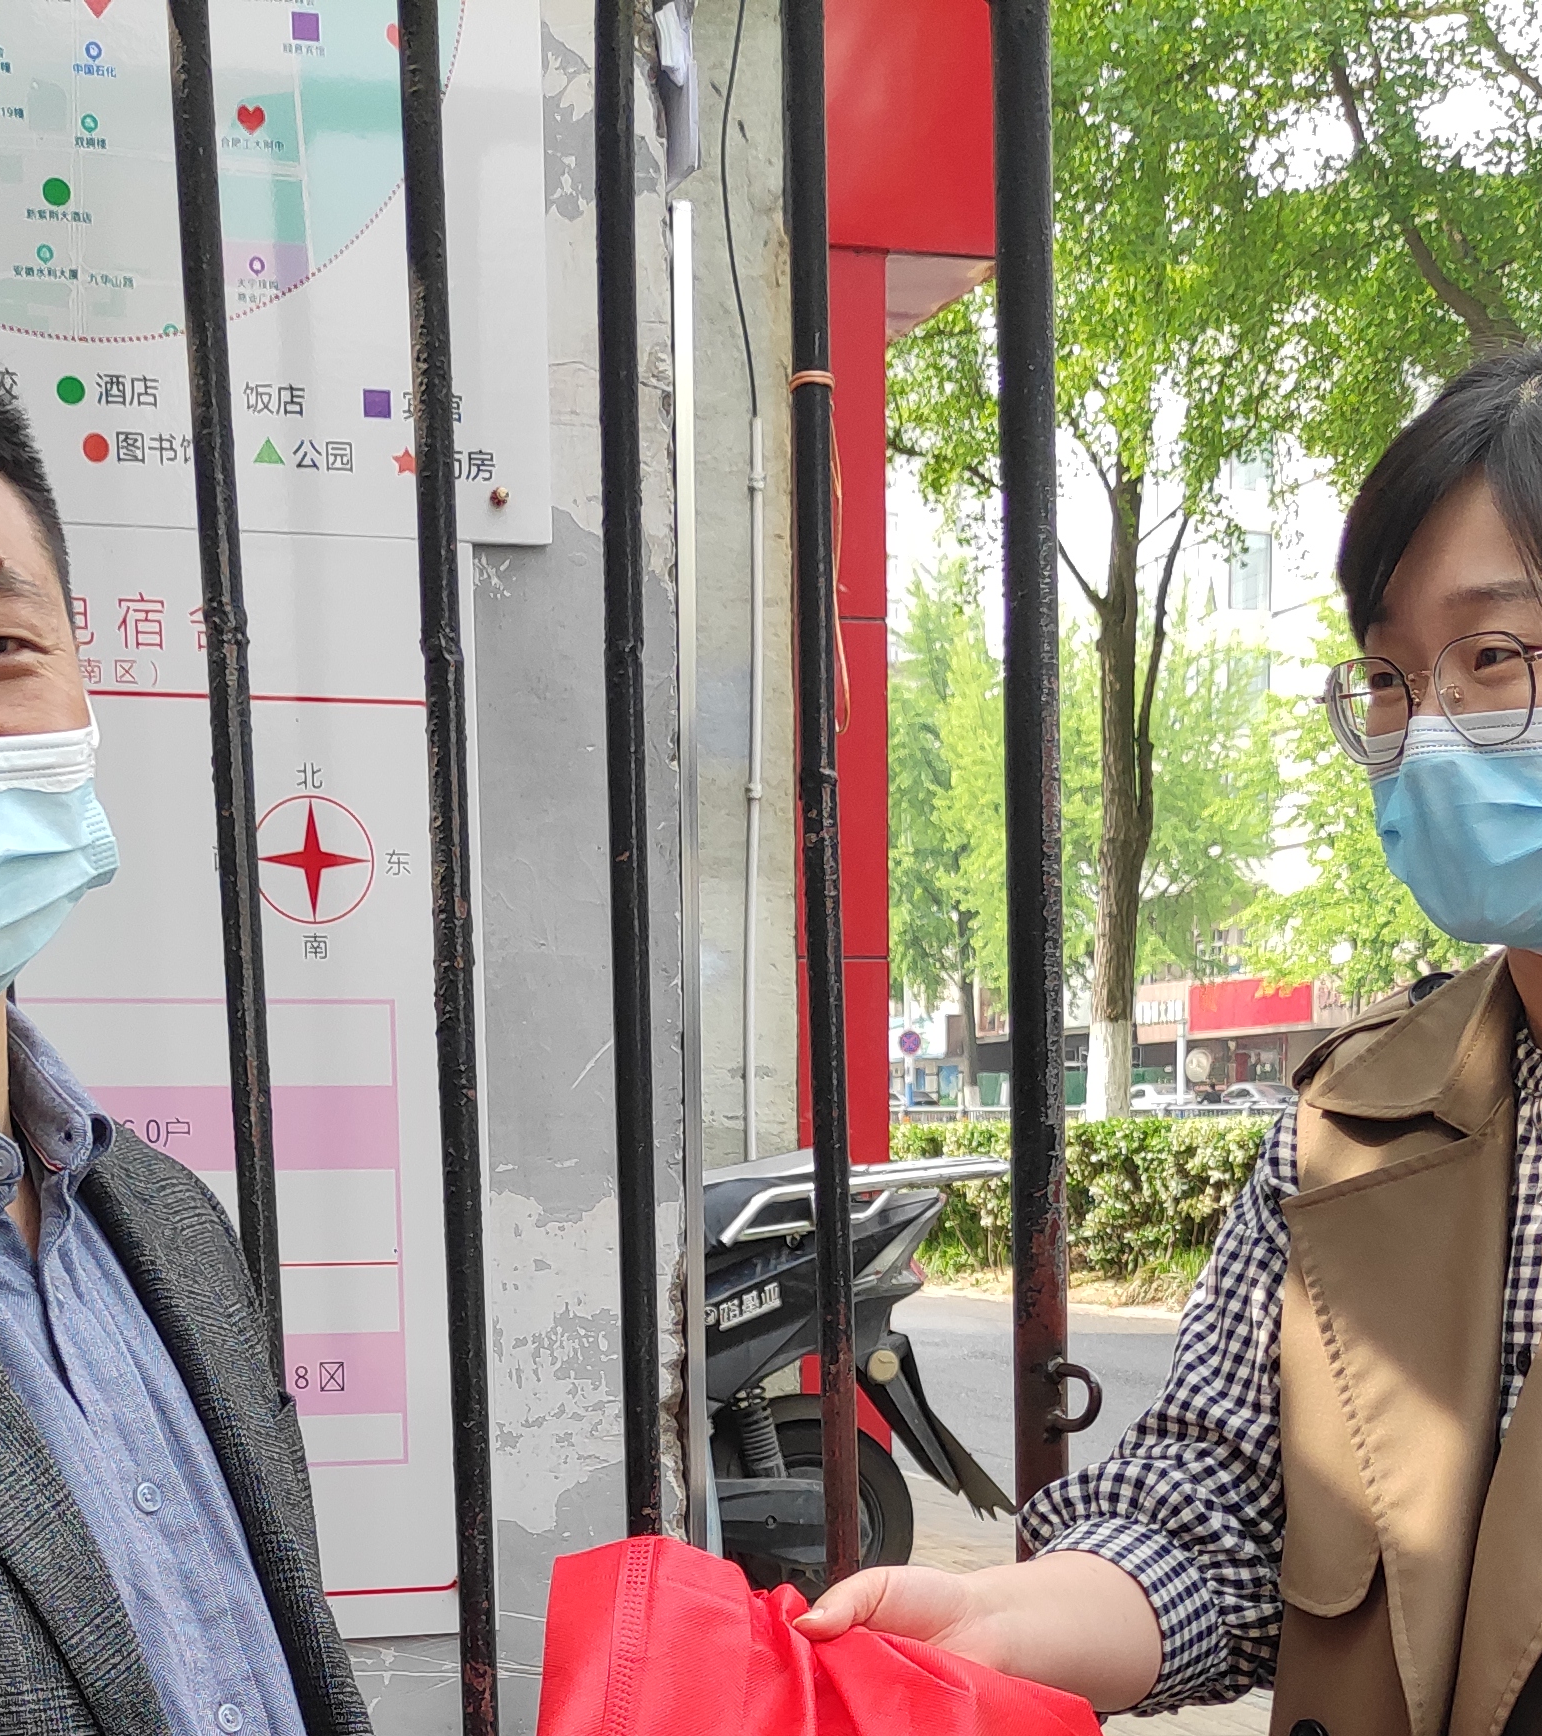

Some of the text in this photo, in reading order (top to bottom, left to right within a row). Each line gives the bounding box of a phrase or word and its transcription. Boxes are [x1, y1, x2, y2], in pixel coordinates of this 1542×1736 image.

[73, 63, 117, 78] 中国石化
[95, 372, 159, 409] 酒店
[243, 381, 305, 418] 饭店
[293, 439, 354, 473] 公园
[296, 762, 323, 791] 北
[385, 849, 411, 876] 东
[302, 932, 328, 960] 南
